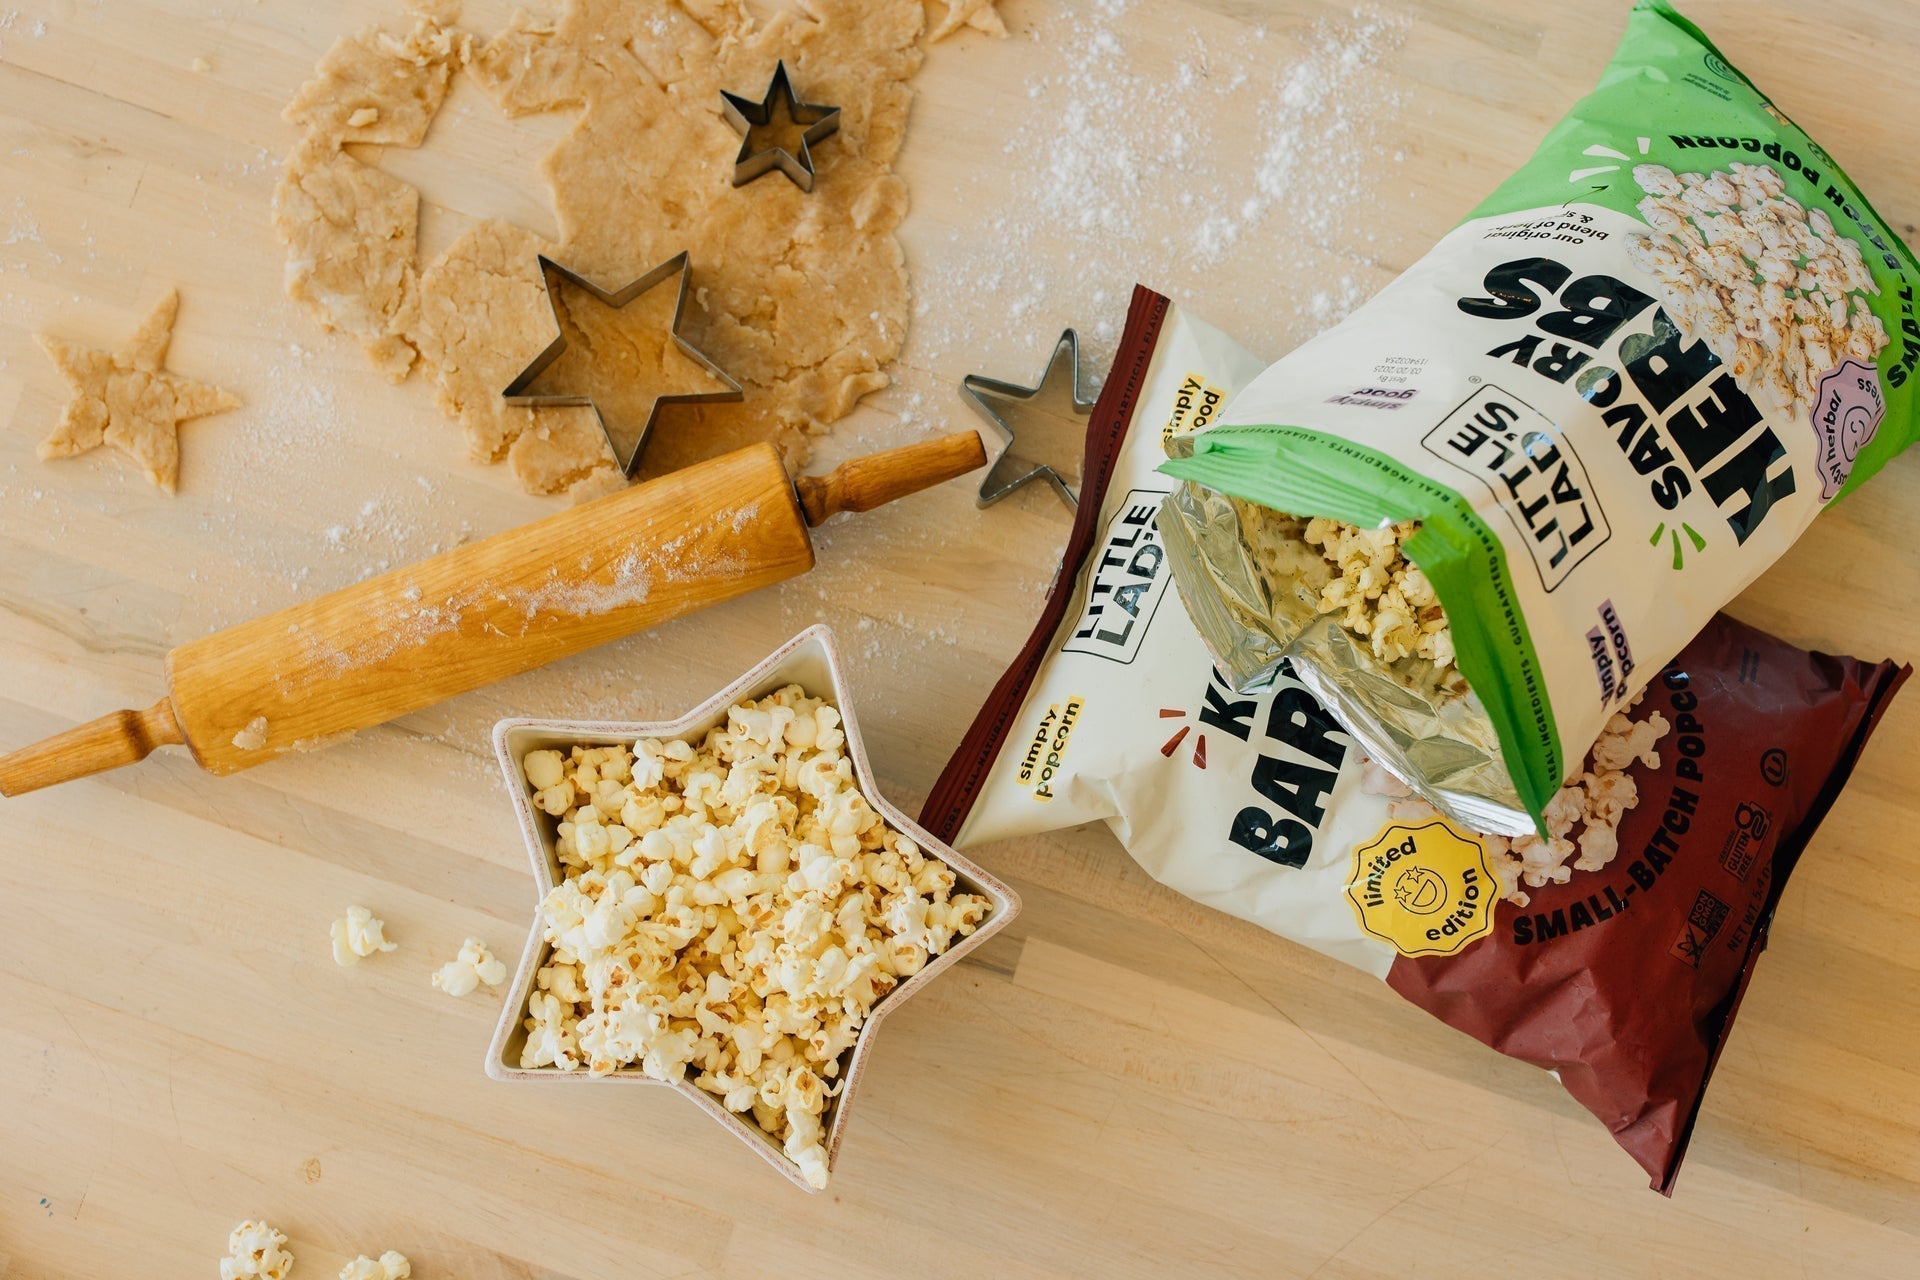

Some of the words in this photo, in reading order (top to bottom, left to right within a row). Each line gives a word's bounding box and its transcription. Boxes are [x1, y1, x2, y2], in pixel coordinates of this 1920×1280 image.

[1667, 134, 1820, 188] POPCORN
[1483, 229, 1552, 240] original
[1533, 221, 1556, 229] of
[1552, 233, 1584, 245] our
[1556, 222, 1609, 240] blend
[1580, 214, 1594, 224] &
[1111, 420, 1121, 440] NO
[1119, 350, 1148, 419] ARTIFICIAL
[1163, 376, 1201, 443] simply
[1191, 390, 1221, 431] ood
[1457, 257, 1797, 547] HERBS
[1486, 334, 1692, 511] SAVORY
[1240, 428, 1317, 442] GUARANTEED
[1823, 389, 1842, 469] herbal
[1328, 442, 1414, 485] INGREDIENTS
[1418, 482, 1450, 503] REAL
[1447, 423, 1568, 569] LITTLE
[1474, 401, 1595, 547] LAD'S
[1460, 512, 1494, 553] FRESH
[1075, 505, 1157, 639] LITTLE
[1095, 519, 1164, 647] LAD'
[1489, 555, 1523, 646] GUARANTEED
[1590, 635, 1614, 702] imply
[1603, 607, 1635, 699] ppcorn
[1520, 659, 1552, 746] INGREDIENTS
[963, 710, 1010, 794] ALL-NATURAL
[1020, 707, 1058, 781] simply
[1036, 701, 1080, 798] popcorn
[1547, 752, 1558, 781] REAL
[1513, 786, 1701, 946] SMALL-BATCH
[1663, 660, 1707, 783] POPCO
[1364, 836, 1417, 908] limited
[1728, 830, 1751, 870] GLUTEN
[1737, 853, 1753, 879] FREE
[1425, 868, 1479, 941] edition
[1690, 895, 1709, 922] NON
[1699, 898, 1716, 927] GMO
[1727, 929, 1746, 952] NET
